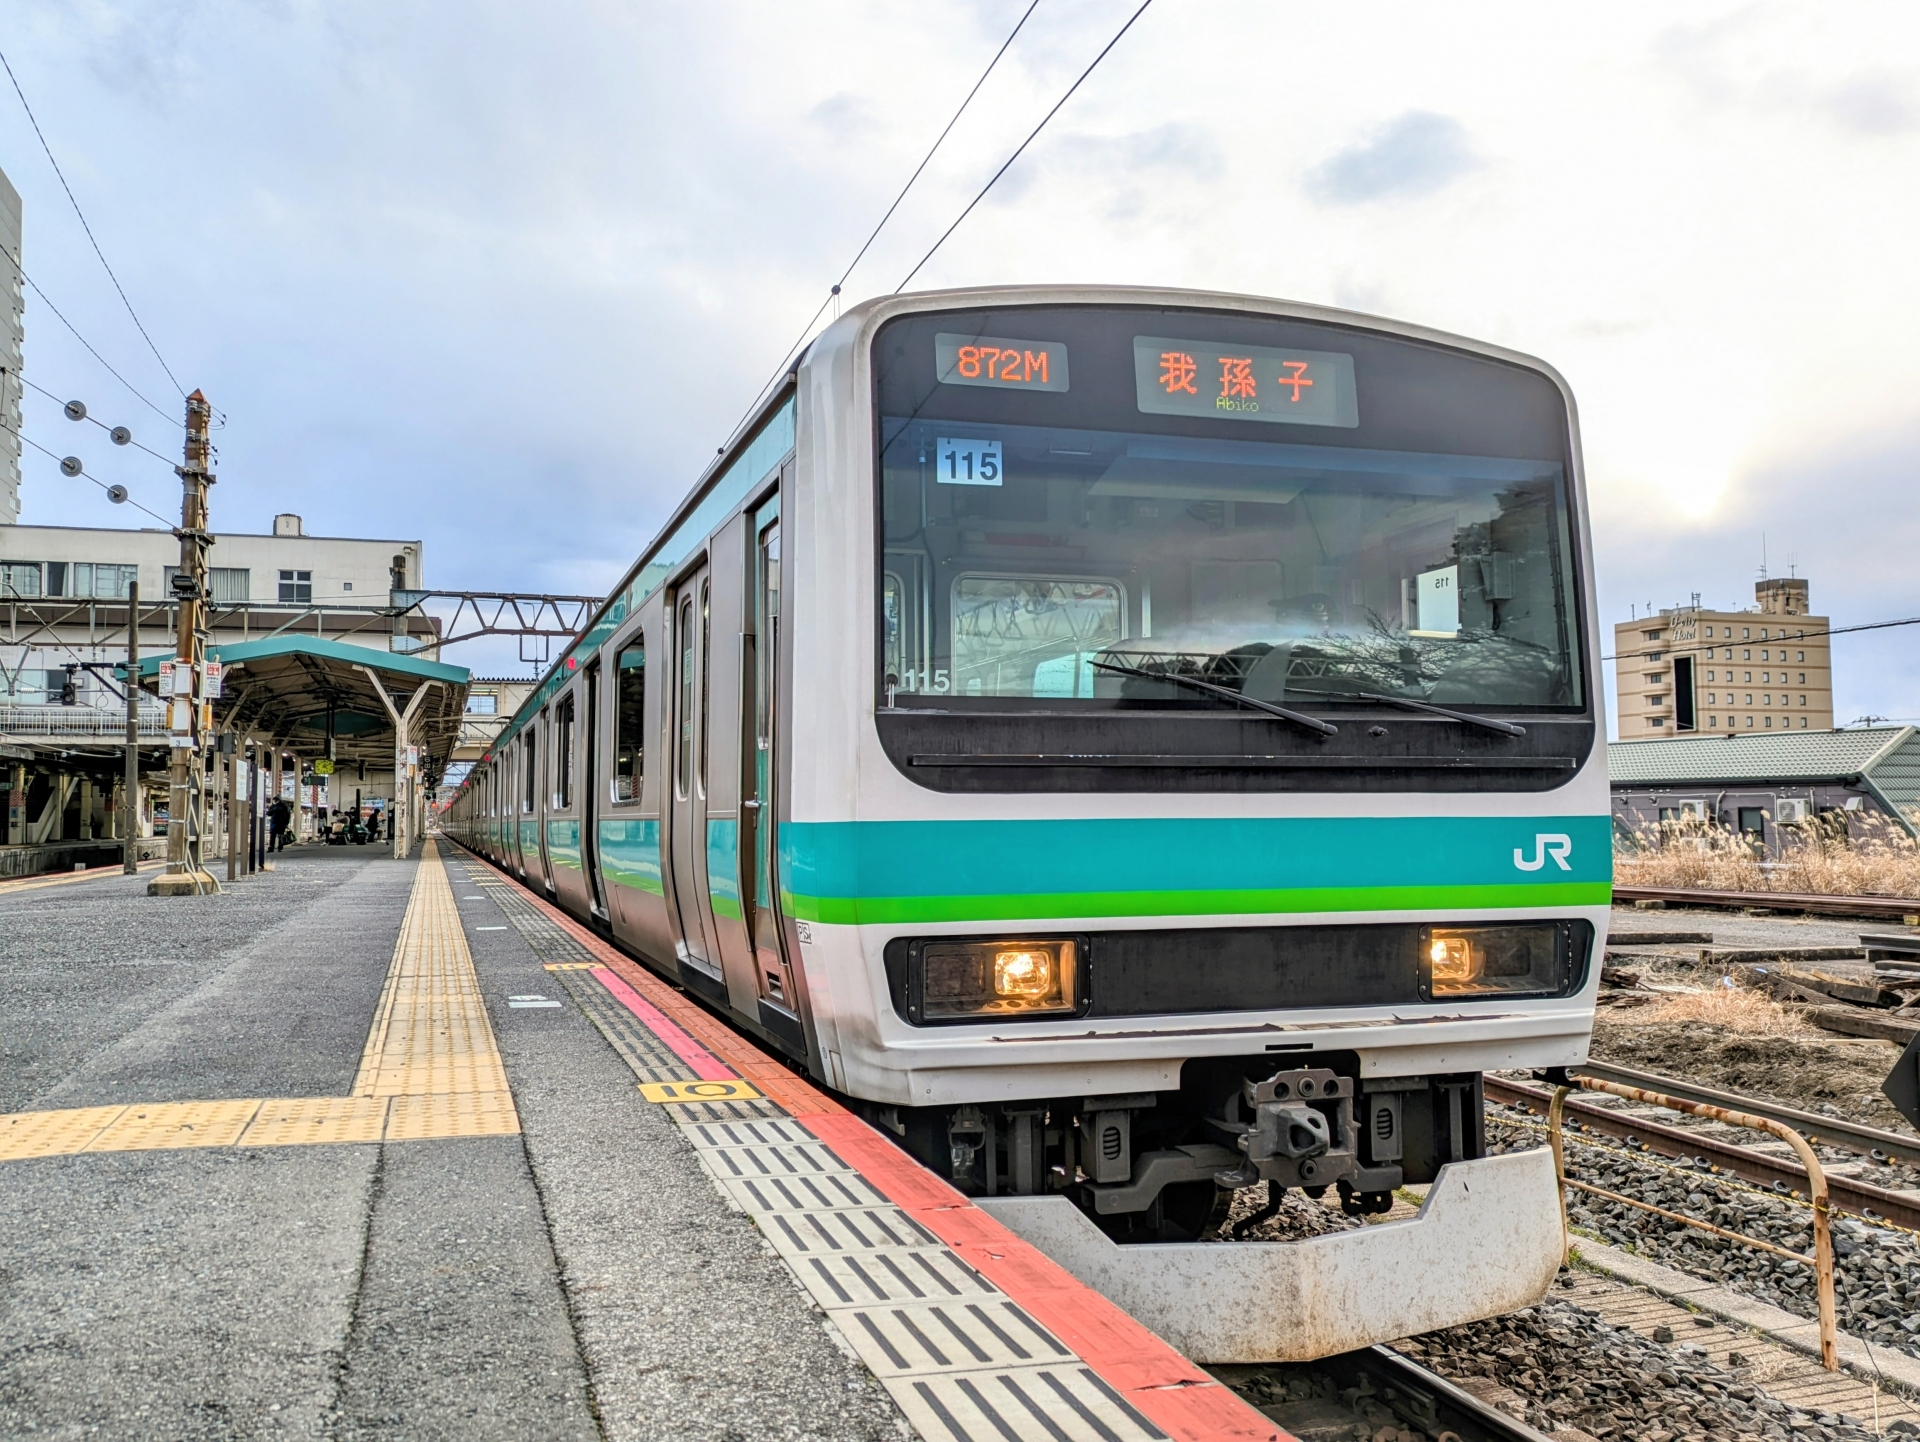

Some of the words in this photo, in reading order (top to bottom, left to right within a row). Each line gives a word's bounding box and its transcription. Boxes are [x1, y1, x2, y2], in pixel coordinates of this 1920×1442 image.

[958, 346, 1048, 382] 872M
[1159, 352, 1313, 402] 我孫子
[1216, 397, 1259, 412] Abiko
[945, 450, 998, 481] 115
[1673, 628, 1696, 641] Hotel
[904, 669, 950, 692] 115
[1513, 833, 1573, 872] JR
[660, 1083, 737, 1097] 10
